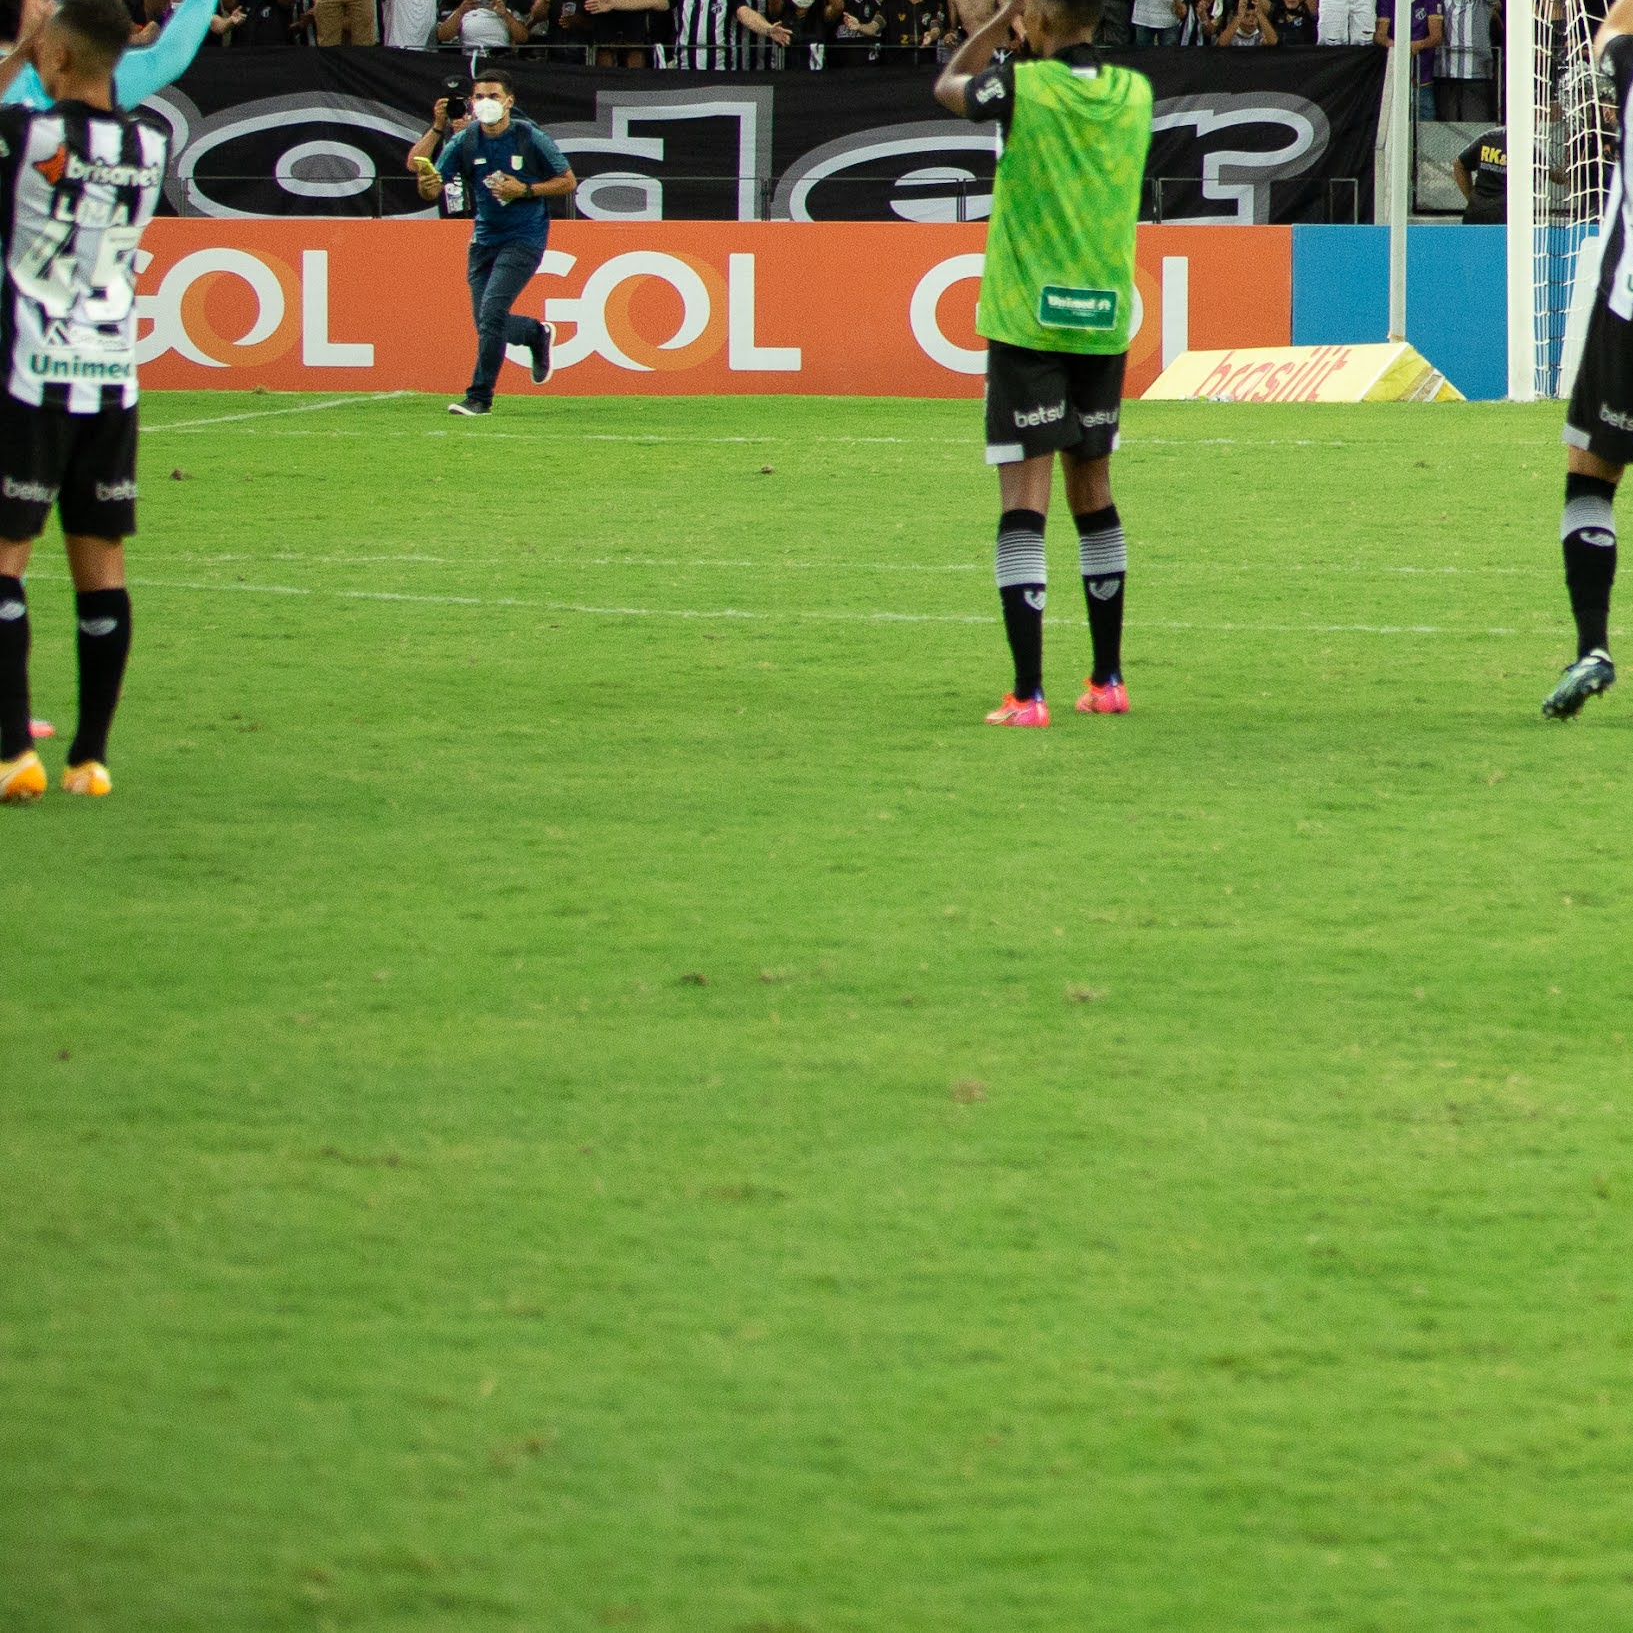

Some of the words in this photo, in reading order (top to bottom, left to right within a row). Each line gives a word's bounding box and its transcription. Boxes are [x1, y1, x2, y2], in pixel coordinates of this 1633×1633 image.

[66, 154, 161, 188] brisanet
[1192, 345, 1353, 404] brasilit
[1013, 400, 1067, 430] betsul
